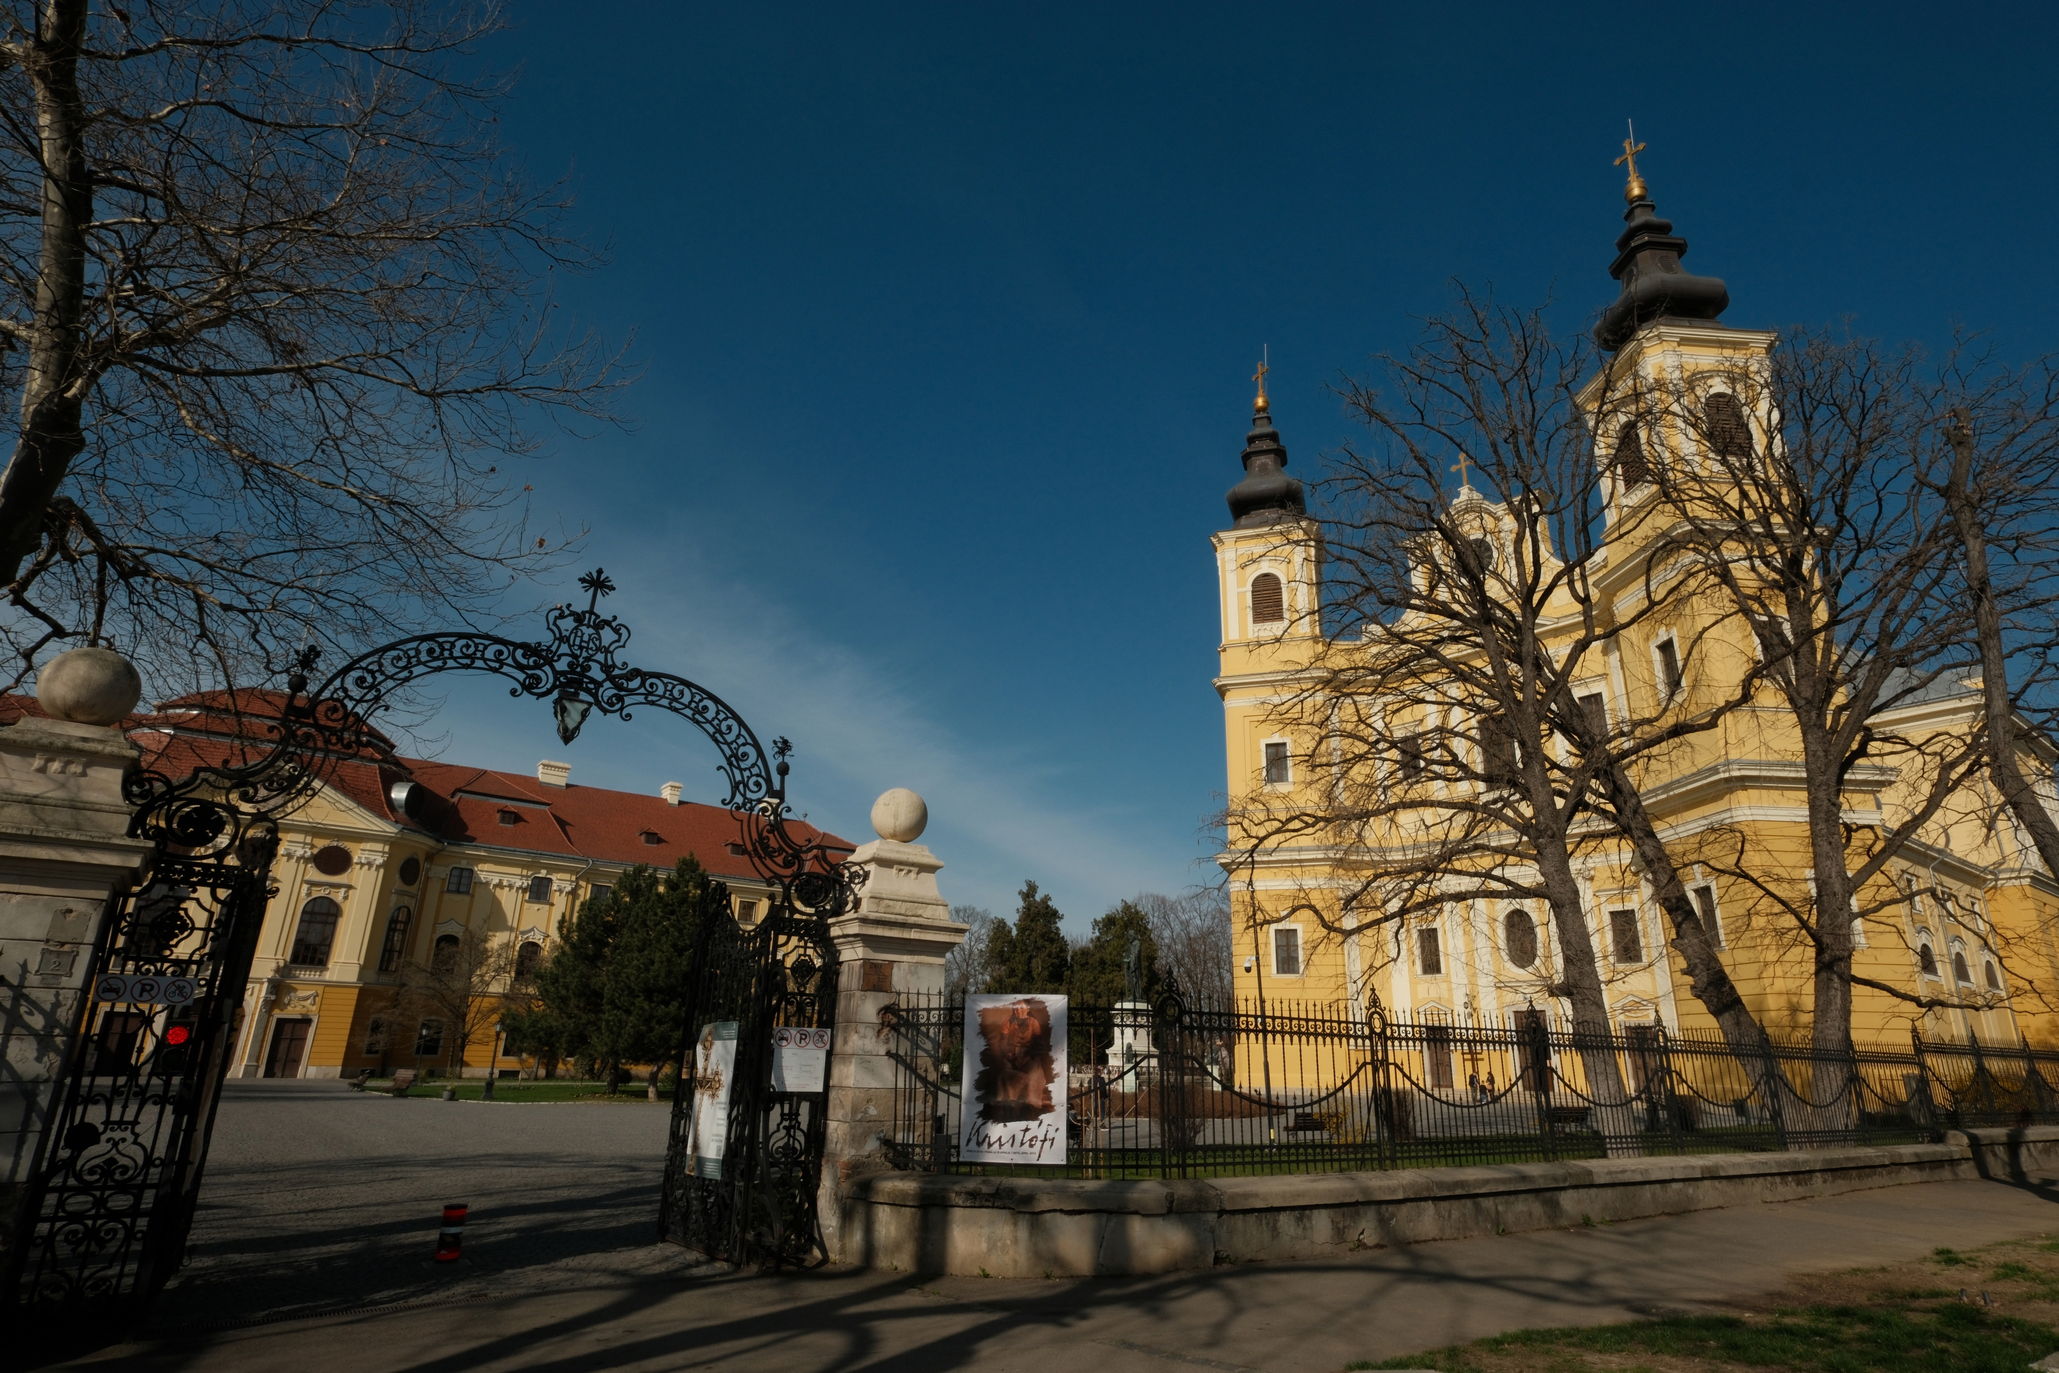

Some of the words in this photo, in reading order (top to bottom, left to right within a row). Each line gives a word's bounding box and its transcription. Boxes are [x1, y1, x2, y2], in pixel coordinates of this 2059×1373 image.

[49, 958, 62, 972] 2
[138, 983, 155, 998] P
[799, 1033, 808, 1045] P
